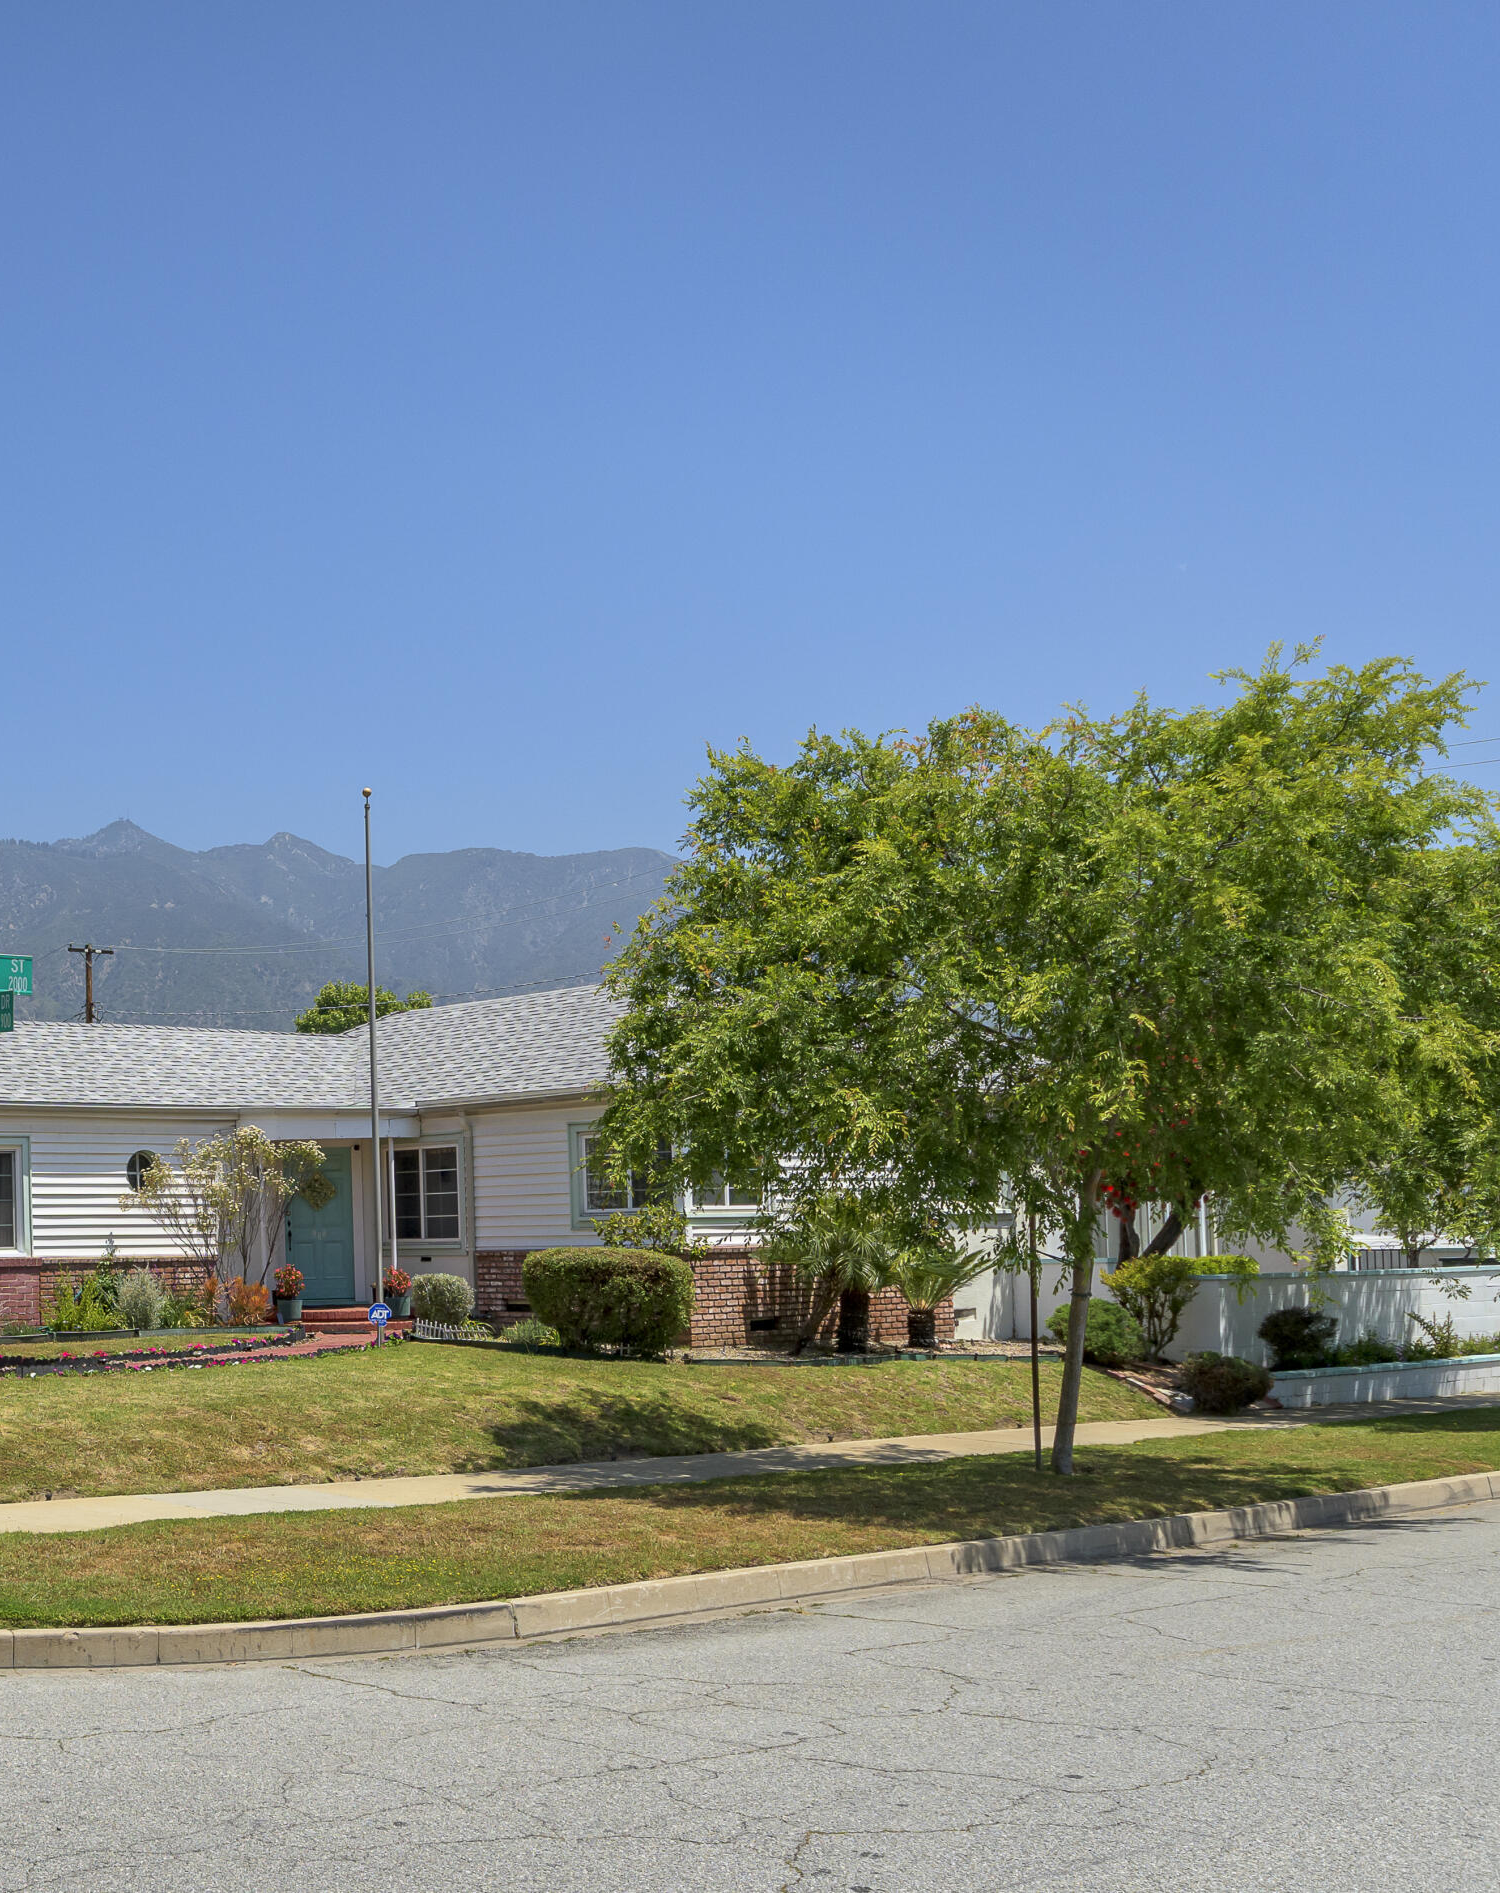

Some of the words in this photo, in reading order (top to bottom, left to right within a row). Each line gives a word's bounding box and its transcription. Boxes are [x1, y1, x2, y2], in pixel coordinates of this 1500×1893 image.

[11, 959, 25, 973] ST
[8, 976, 28, 992] 2000
[1, 994, 11, 1010] DR
[371, 1309, 389, 1319] ADT
